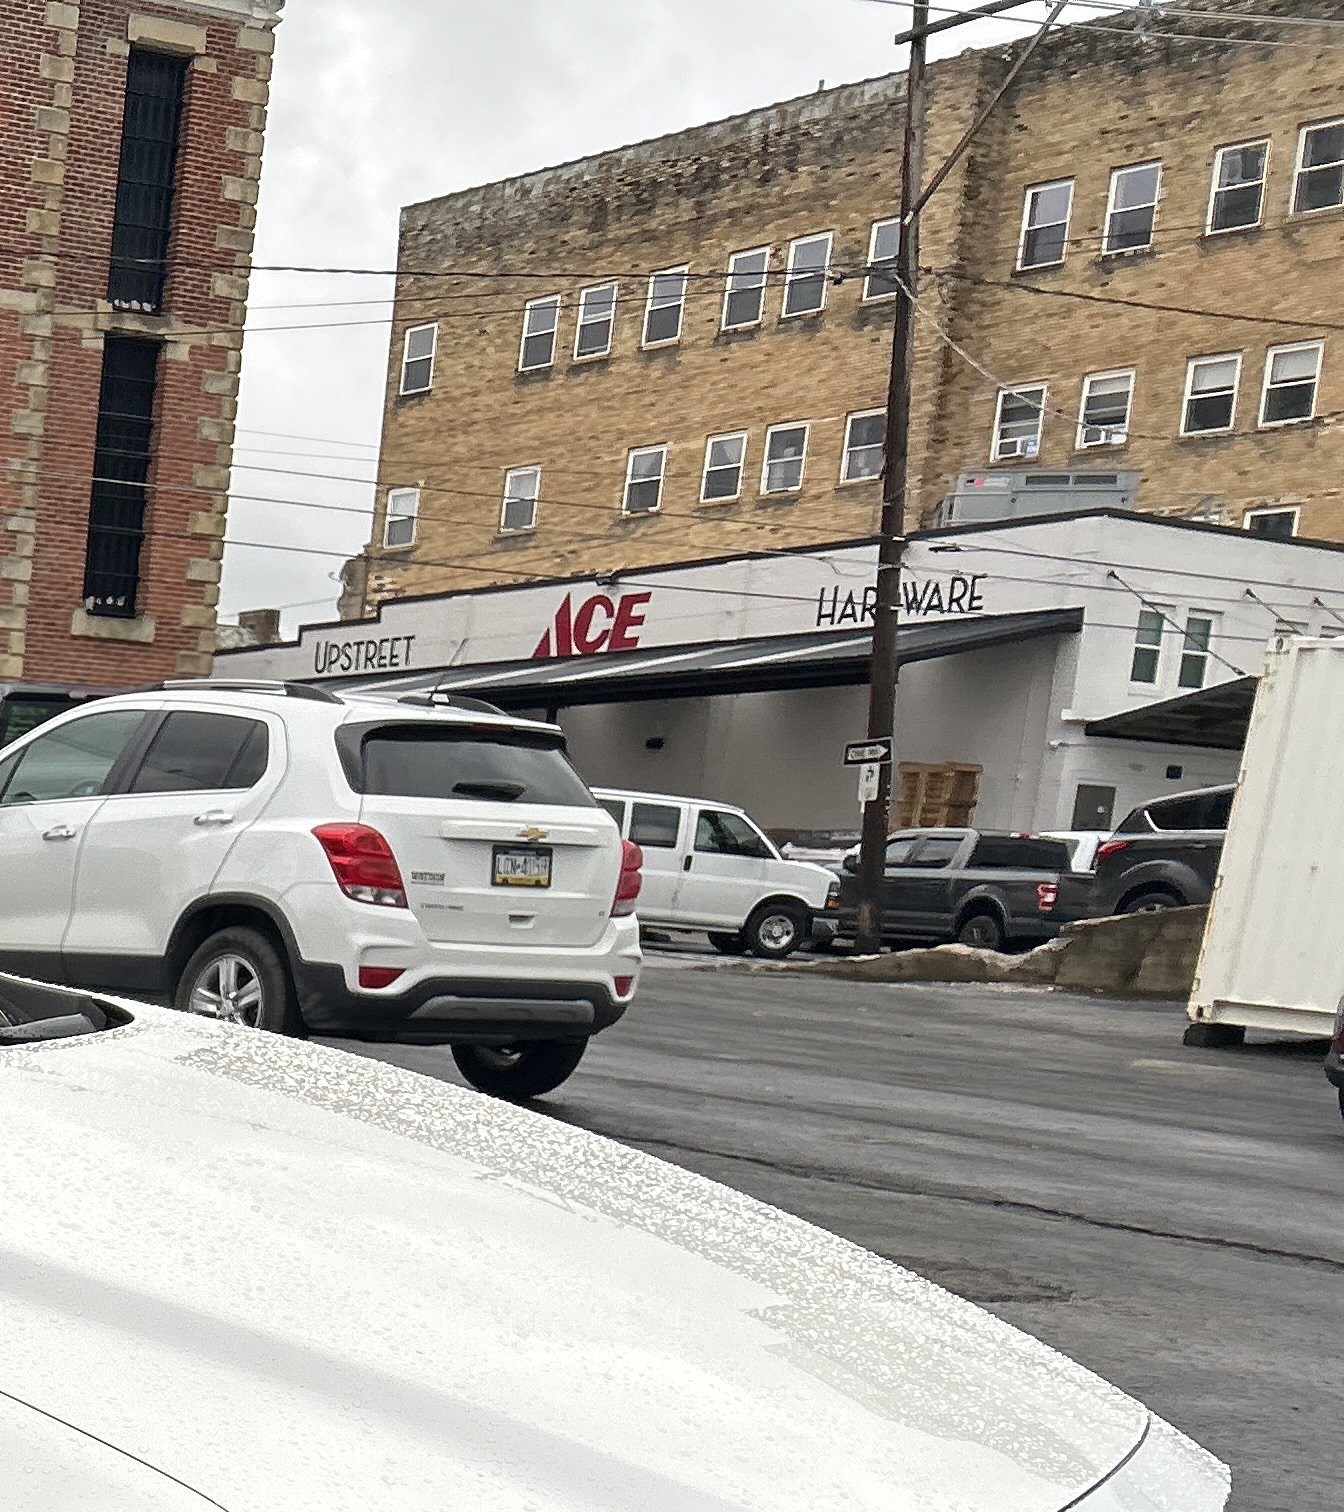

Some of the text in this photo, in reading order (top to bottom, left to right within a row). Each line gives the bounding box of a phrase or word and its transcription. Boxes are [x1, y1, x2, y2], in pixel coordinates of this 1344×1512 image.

[314, 573, 988, 674] UPSTREET ACE HARWARE
